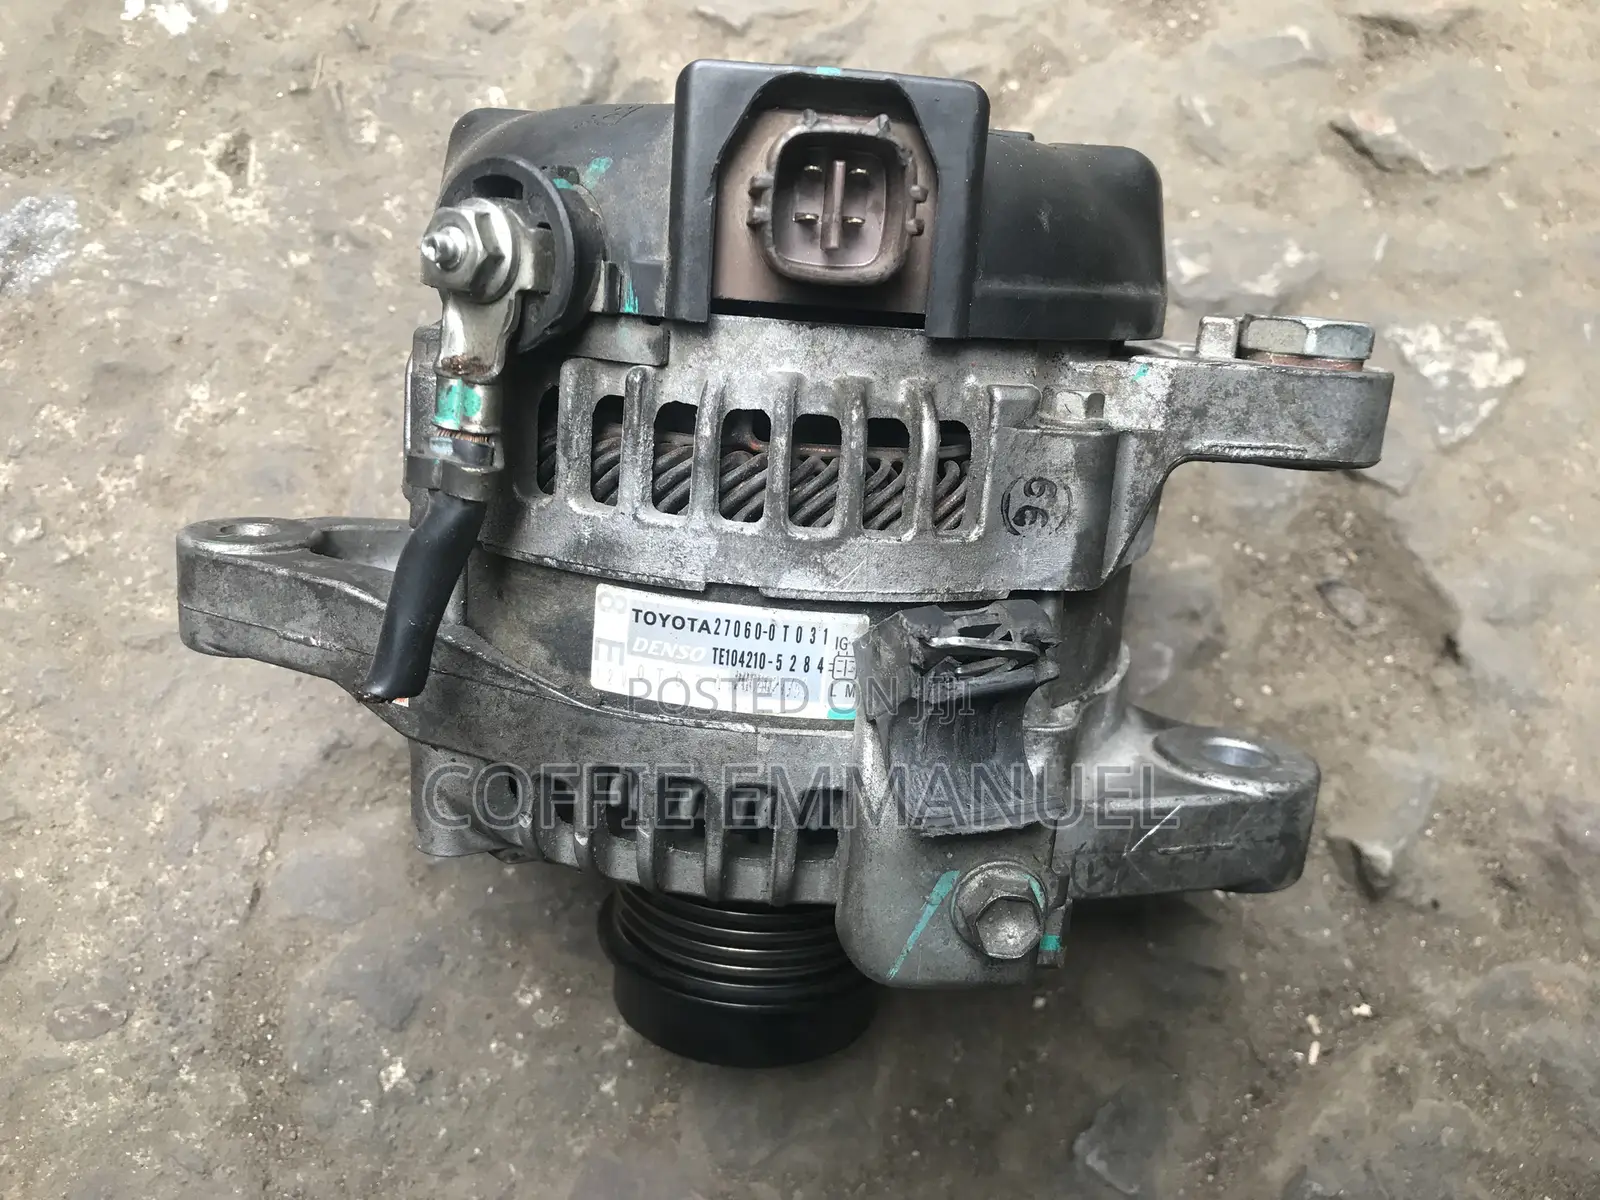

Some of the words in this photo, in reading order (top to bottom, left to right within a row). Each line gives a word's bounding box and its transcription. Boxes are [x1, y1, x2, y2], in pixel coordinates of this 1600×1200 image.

[631, 607, 712, 635] TOYOTA
[713, 617, 829, 646] 27060-0T031
[631, 636, 708, 663] DENSO
[834, 635, 849, 651] IG
